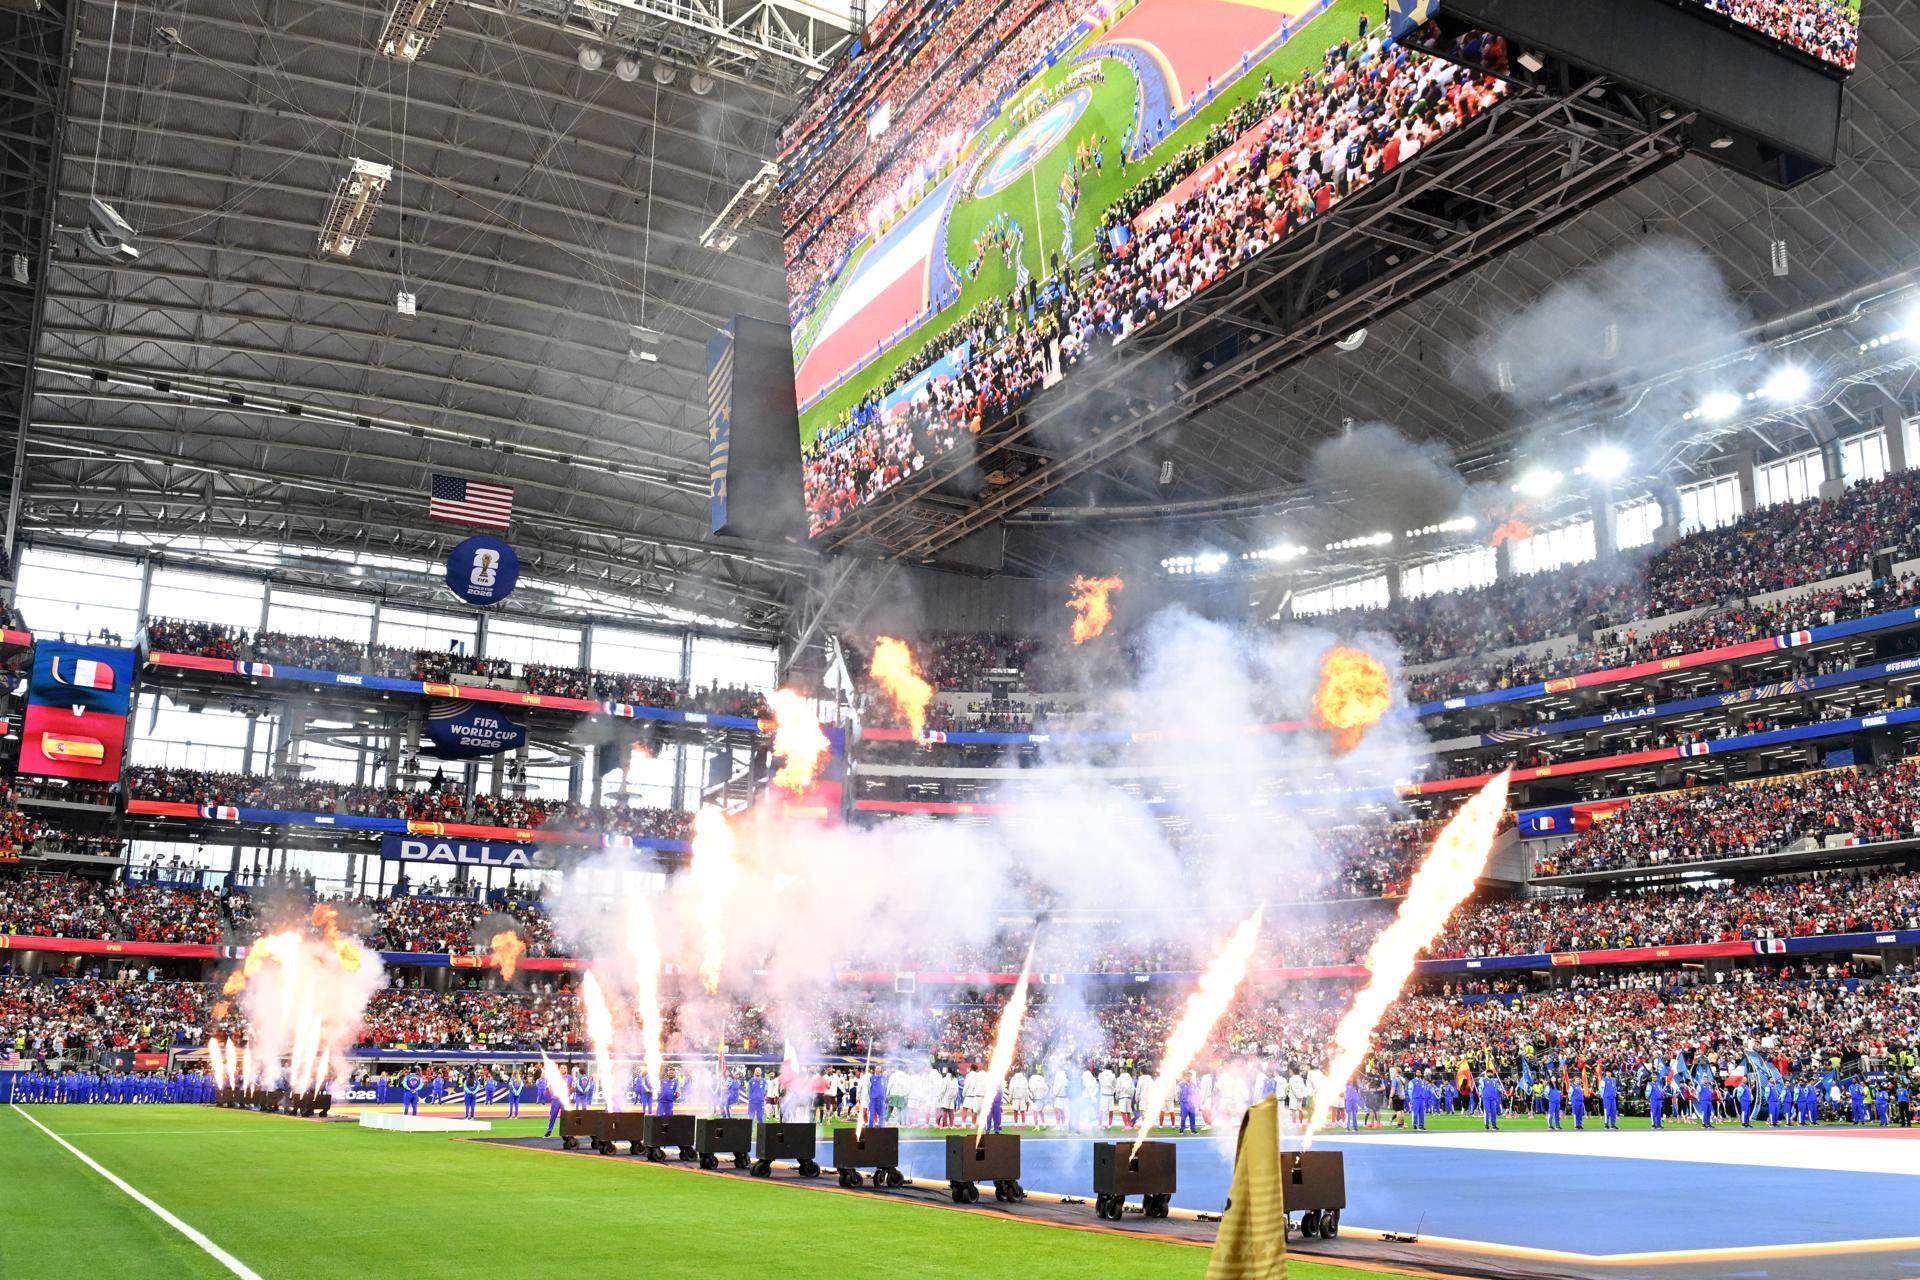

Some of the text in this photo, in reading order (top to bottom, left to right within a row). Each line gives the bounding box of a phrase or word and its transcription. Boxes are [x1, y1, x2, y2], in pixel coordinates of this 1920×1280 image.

[467, 588, 493, 597] 2026
[1661, 658, 1680, 669] SPAIN
[336, 674, 363, 685] FRANCE
[522, 695, 541, 704] SPAIN
[1602, 707, 1656, 722] DALLAS
[473, 717, 499, 729] FIFA
[1862, 715, 1888, 728] FRANCE
[450, 724, 517, 740] WORLD CUP
[460, 737, 501, 748] 2026
[1875, 935, 1897, 943] FRANCE
